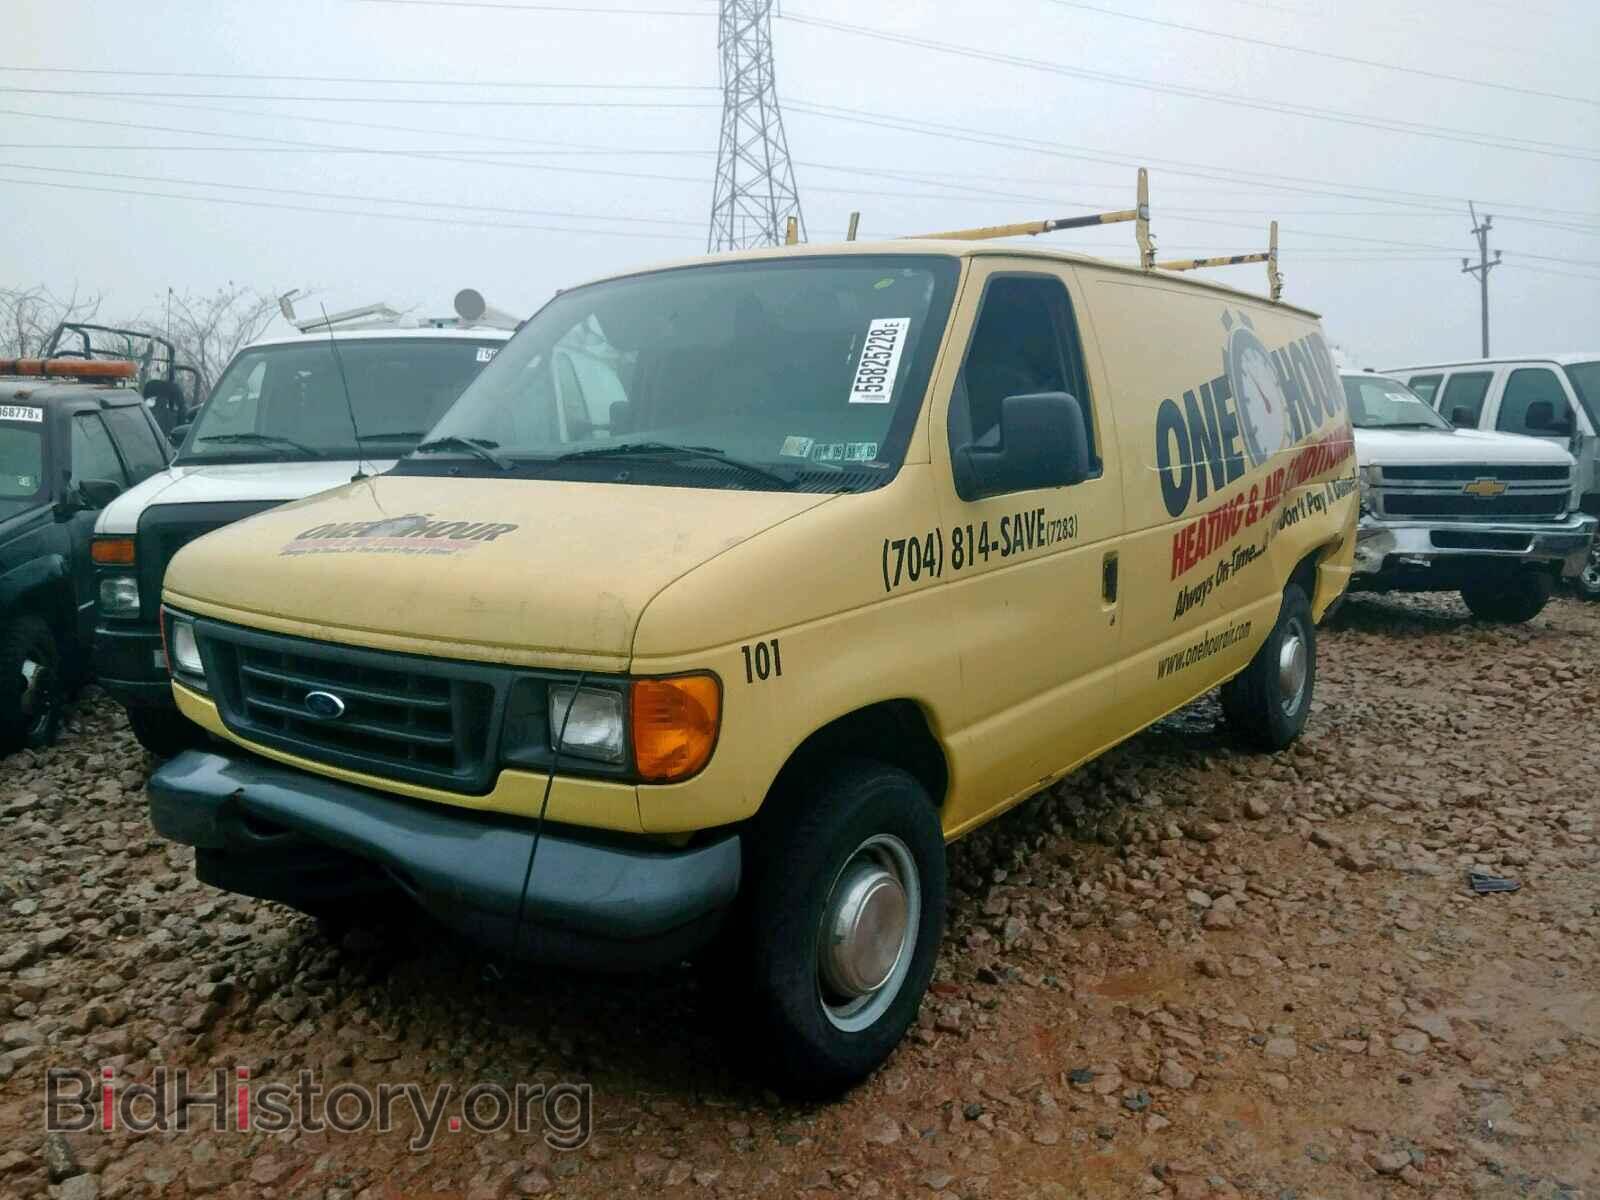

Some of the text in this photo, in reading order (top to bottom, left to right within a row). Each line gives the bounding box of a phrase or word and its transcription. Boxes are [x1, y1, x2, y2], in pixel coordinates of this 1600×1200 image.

[1156, 374, 1245, 517] ONE
[396, 520, 519, 541] HOUR
[882, 527, 943, 592] (704)
[1171, 493, 1245, 582] HEATING
[1245, 483, 1260, 528] &
[1173, 574, 1214, 621] Always
[1306, 491, 1327, 515] Pay
[741, 638, 782, 684] 101
[1157, 620, 1251, 680] www.onehourair.com
